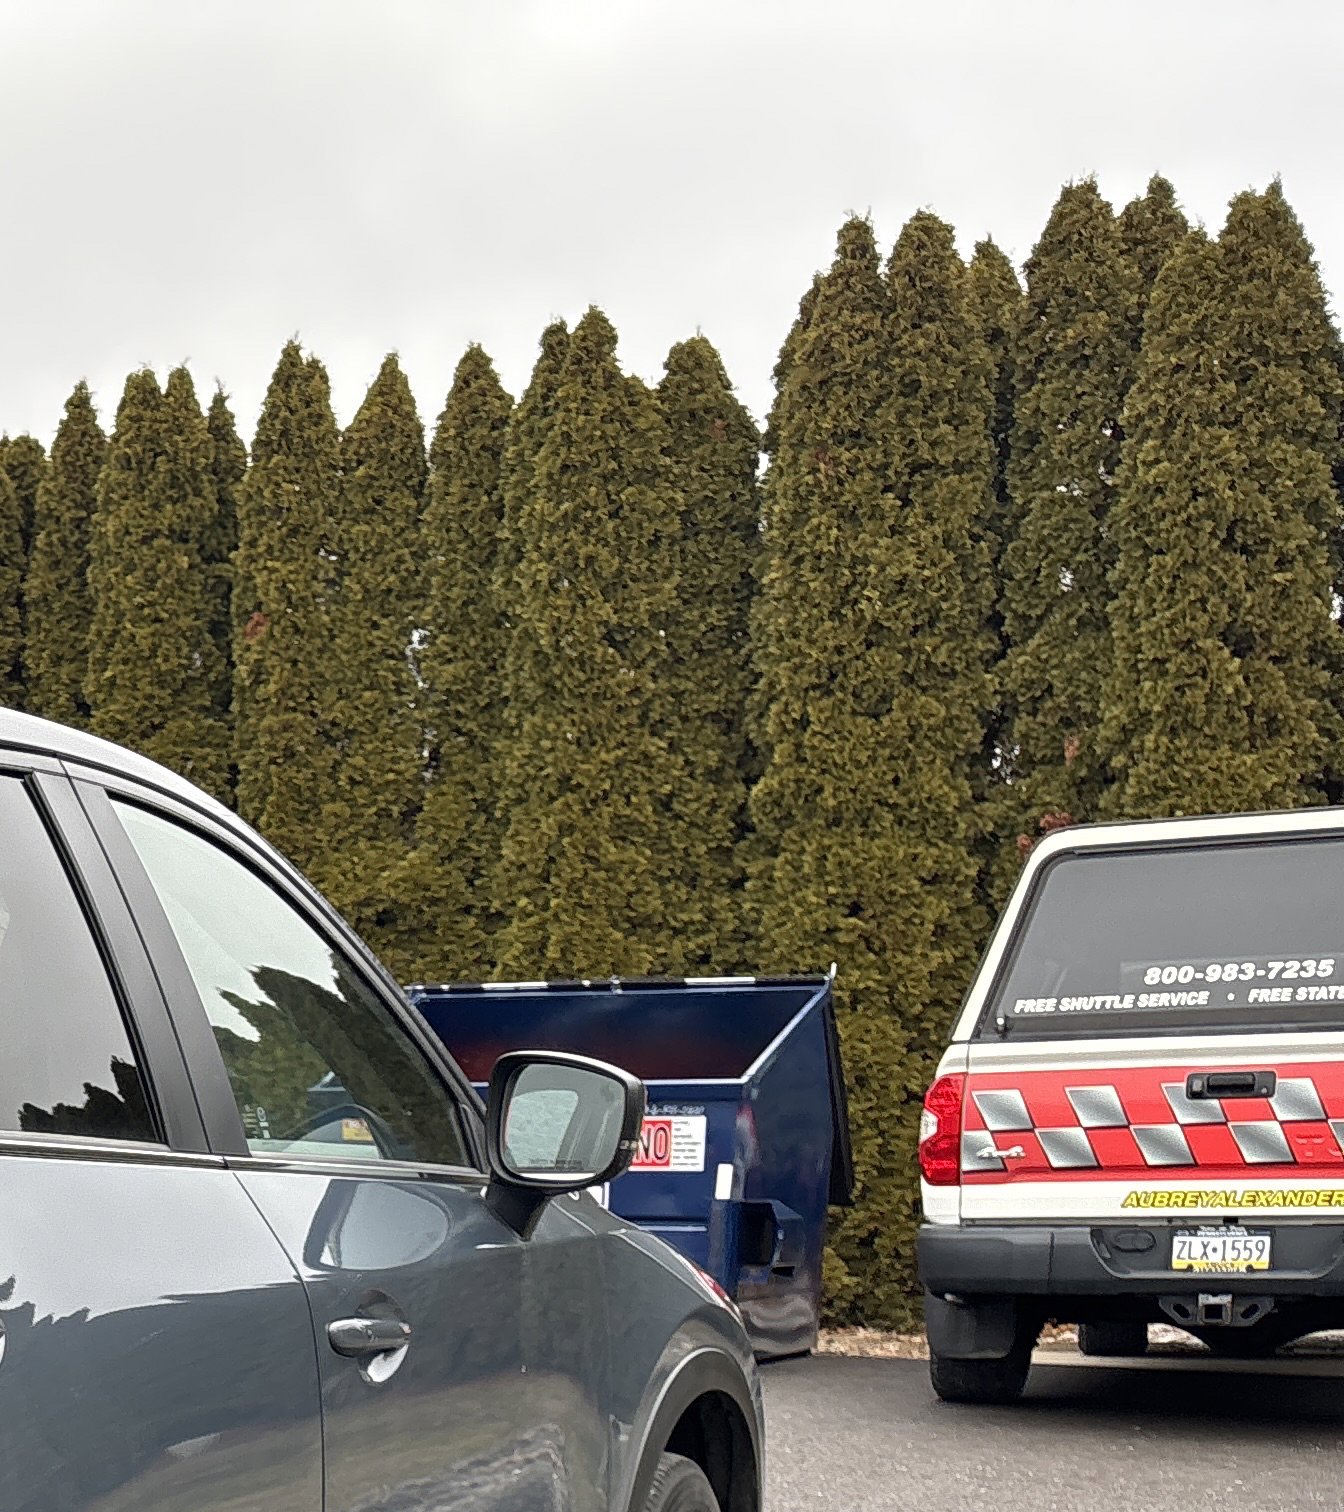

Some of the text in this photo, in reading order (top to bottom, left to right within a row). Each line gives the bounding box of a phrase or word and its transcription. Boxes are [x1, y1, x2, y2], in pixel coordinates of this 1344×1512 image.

[1143, 958, 1336, 986] 800-983-7235
[1013, 995, 1058, 1014] FREE
[1058, 992, 1136, 1012] SHUTTLE
[1136, 989, 1210, 1008] SERVICE
[1247, 986, 1294, 1003] FREE
